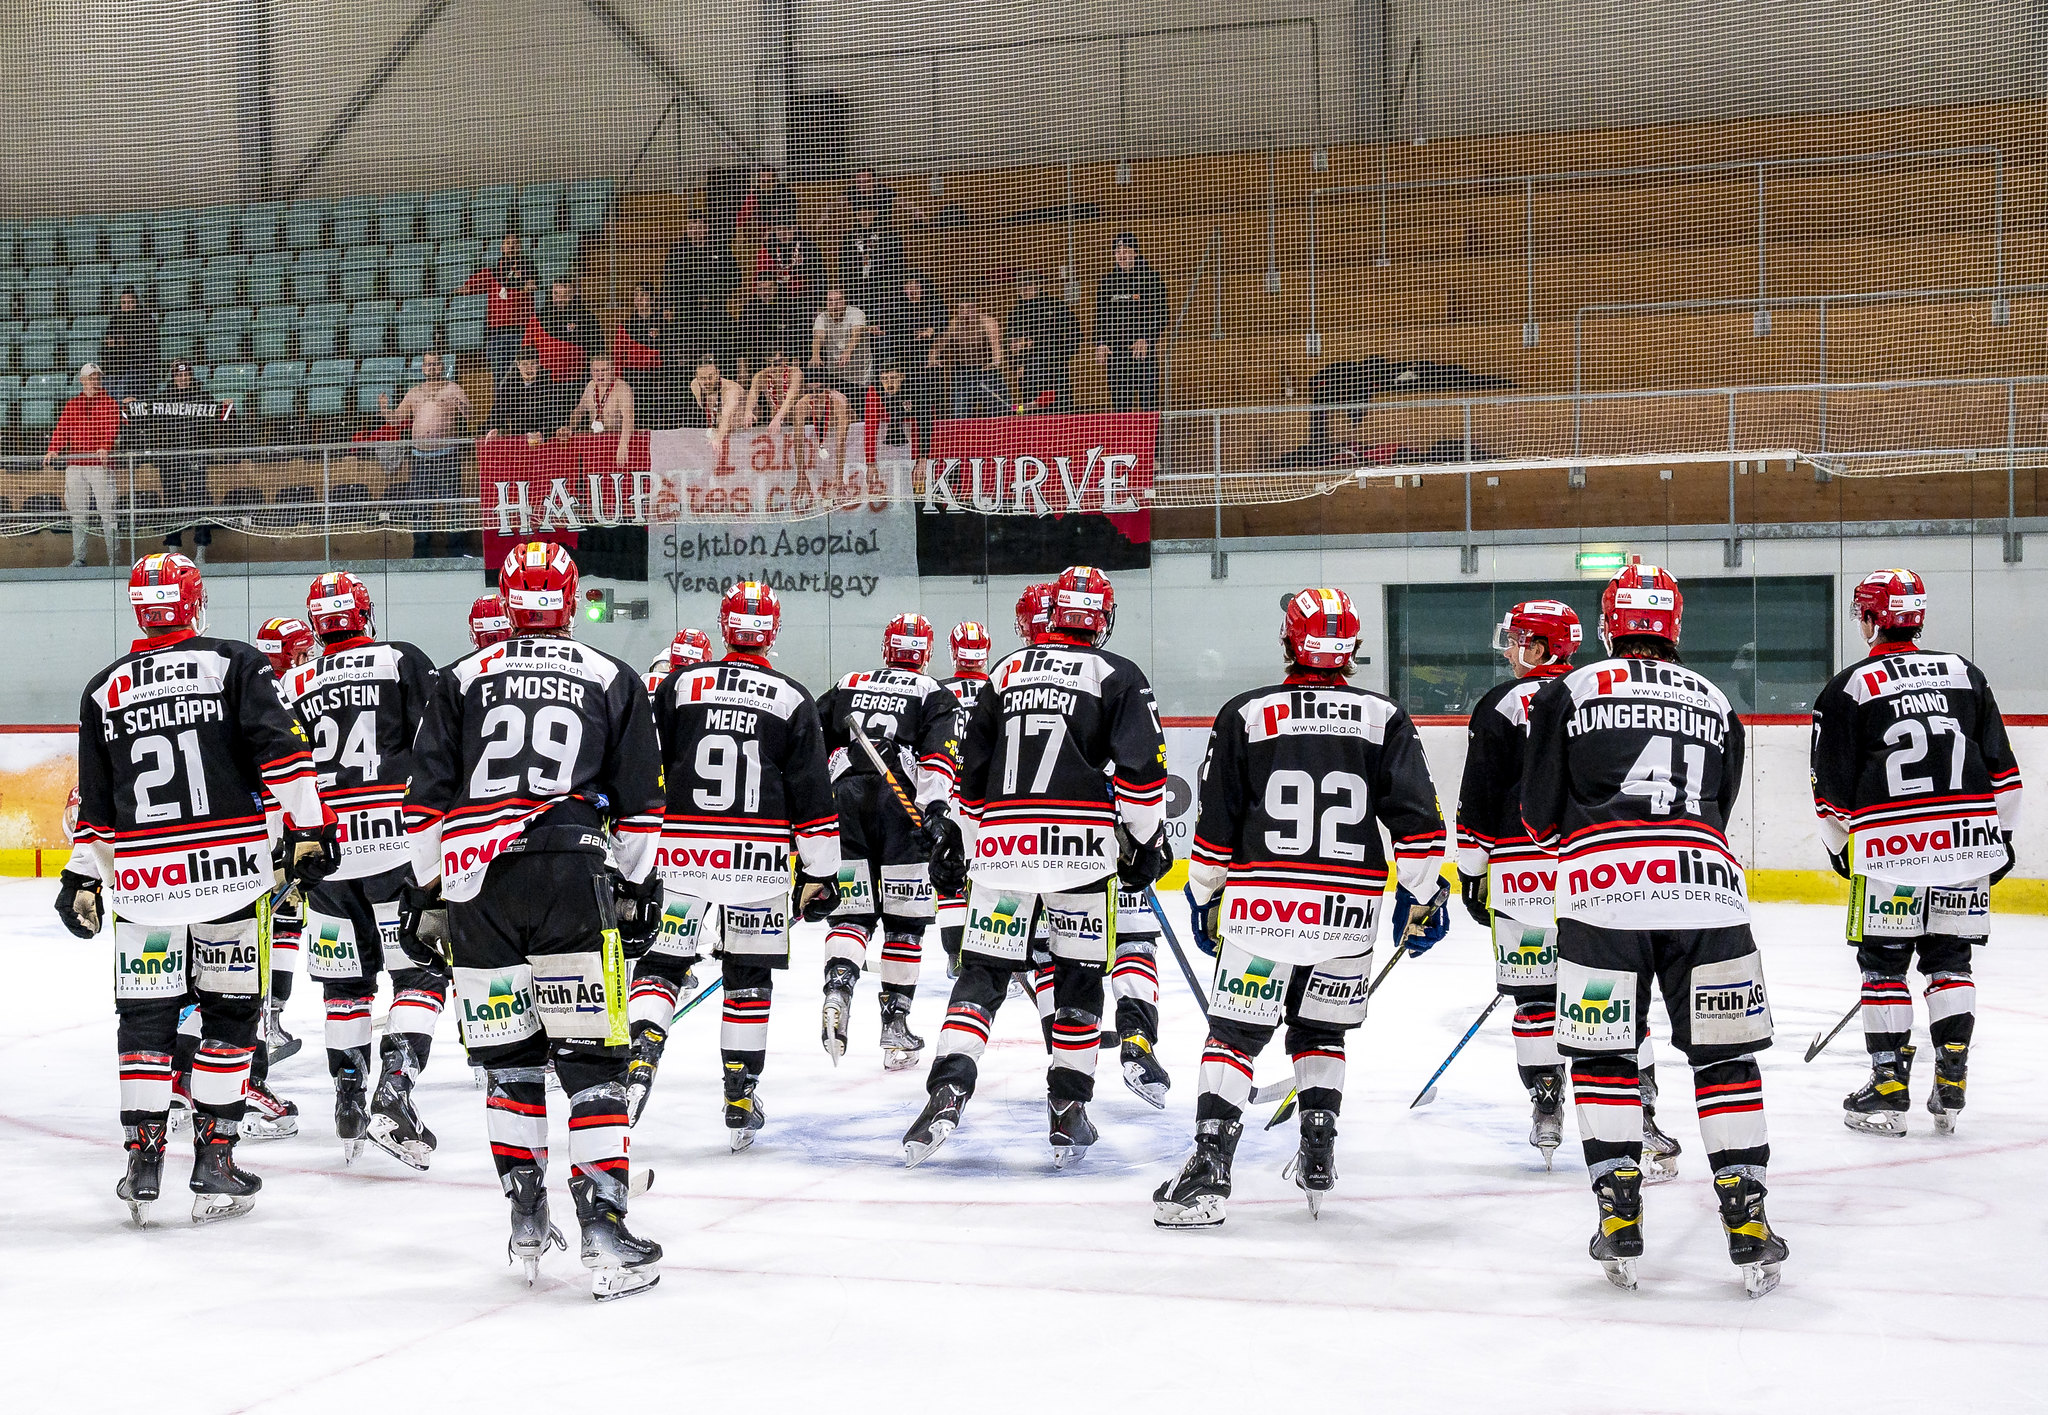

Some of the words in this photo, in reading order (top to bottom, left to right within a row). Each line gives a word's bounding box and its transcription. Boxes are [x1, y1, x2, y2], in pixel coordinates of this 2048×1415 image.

[152, 402, 217, 417] FRAUENFELD
[294, 655, 376, 697] plica
[317, 670, 374, 687] www.plica.ch
[505, 661, 583, 677] www.plica.ch
[1002, 651, 1084, 688] plica
[1020, 674, 1078, 688] www.plica.ch
[1596, 660, 1710, 696] plica
[1862, 658, 1949, 697] plica
[107, 658, 198, 708] plica
[132, 683, 199, 701] www.plica.ch
[481, 682, 497, 707] F.
[505, 676, 584, 708] MOSER
[691, 668, 778, 702] plica
[1894, 680, 1952, 692] www.plica.ch
[300, 684, 380, 722] HOLSTEIN
[714, 694, 774, 711] www.plica.ch
[851, 693, 908, 715] GERBER
[1003, 688, 1078, 716] CRAMERI
[1632, 688, 1711, 708] www.plica.ch
[1888, 690, 1949, 718] TANNÒ
[124, 696, 224, 735] SCHLÄPPI
[706, 708, 758, 734] MEIER
[1263, 692, 1362, 736] plica
[1292, 724, 1362, 735] www.plica.ch
[1566, 703, 1725, 754] HUNGERBÜHL
[312, 710, 382, 787] 24
[470, 704, 583, 799] 29
[1002, 714, 1068, 795] 17
[1883, 716, 1966, 798] 27
[130, 729, 210, 824] 21
[692, 734, 762, 813] 91
[1620, 735, 1706, 816] 41
[1264, 770, 1367, 862] 92
[356, 844, 376, 854] DER
[1866, 819, 2002, 858] novalink
[654, 842, 789, 873] novalink
[1020, 860, 1040, 868] AUS
[1043, 860, 1063, 869] DER
[1866, 862, 1884, 870] IHR
[1886, 856, 1930, 868] IT-PROFI
[1933, 853, 1954, 864] AUS
[1956, 852, 1974, 861] DER
[669, 870, 708, 880] IT-PROFI
[710, 873, 732, 882] AUS
[735, 874, 754, 883] DER
[1568, 850, 1744, 897] novalink
[168, 889, 192, 900] AUS
[196, 886, 220, 898] DER
[840, 881, 869, 898] ndi
[884, 883, 914, 896] Früh
[916, 884, 932, 896] AG
[1518, 896, 1555, 906] IT-PROF
[1571, 901, 1588, 912] IHR
[1590, 891, 1646, 906] IT-PROFI
[1651, 890, 1680, 902] AUS
[1684, 890, 1712, 902] DER
[1930, 891, 1967, 909] Früh
[1969, 891, 1988, 909] AG
[727, 911, 760, 929] Früh
[762, 913, 784, 928] AG
[970, 908, 1028, 938] Landi
[1080, 914, 1103, 933] AG
[1230, 894, 1374, 930] novalink
[380, 926, 400, 943] Frü
[659, 918, 698, 937] ndi
[1228, 926, 1243, 936] IHR
[1246, 927, 1295, 938] IT-PROFI
[1298, 930, 1320, 940] AUS
[1323, 932, 1342, 942] DER
[230, 946, 256, 964] AG
[308, 934, 355, 960] Landi
[120, 950, 182, 974] Landi
[535, 984, 573, 1004] Früh
[576, 983, 605, 1004] AG
[1218, 969, 1284, 1002] Landi
[1308, 977, 1351, 998] Früh
[1353, 980, 1369, 996] AG
[1695, 992, 1744, 1011] Früh
[1747, 984, 1764, 1008] AG
[462, 987, 532, 1022] Landi
[1560, 992, 1630, 1024] Landi
[1695, 1011, 1744, 1020] Steueranlagen
[1558, 1018, 1631, 1036] THULA
